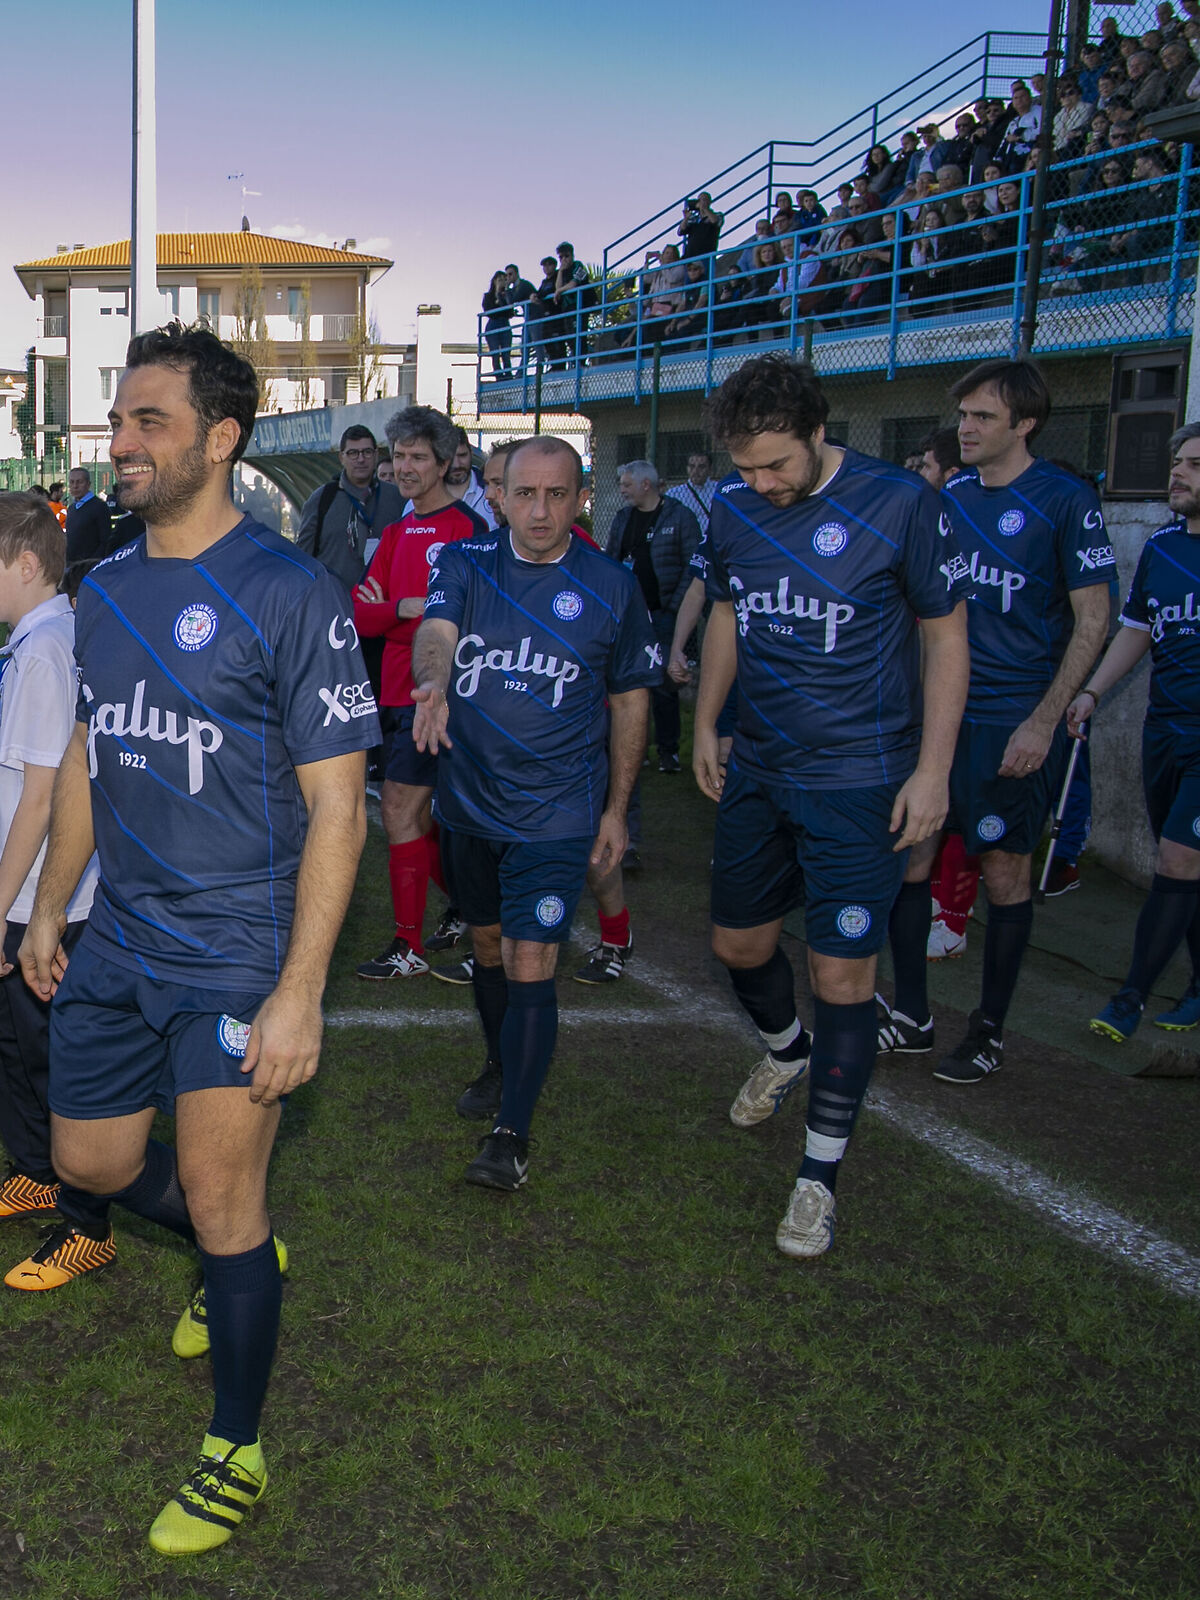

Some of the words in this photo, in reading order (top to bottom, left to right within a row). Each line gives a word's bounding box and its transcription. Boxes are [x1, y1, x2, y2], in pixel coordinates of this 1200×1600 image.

[278, 415, 317, 446] CORBETTA
[729, 576, 855, 653] Galup
[1147, 592, 1200, 642] Gal
[768, 624, 793, 635] 1922
[178, 641, 200, 651] CALCIO
[454, 634, 580, 708] Galup
[504, 680, 528, 692] 1922
[118, 751, 147, 769] 1922
